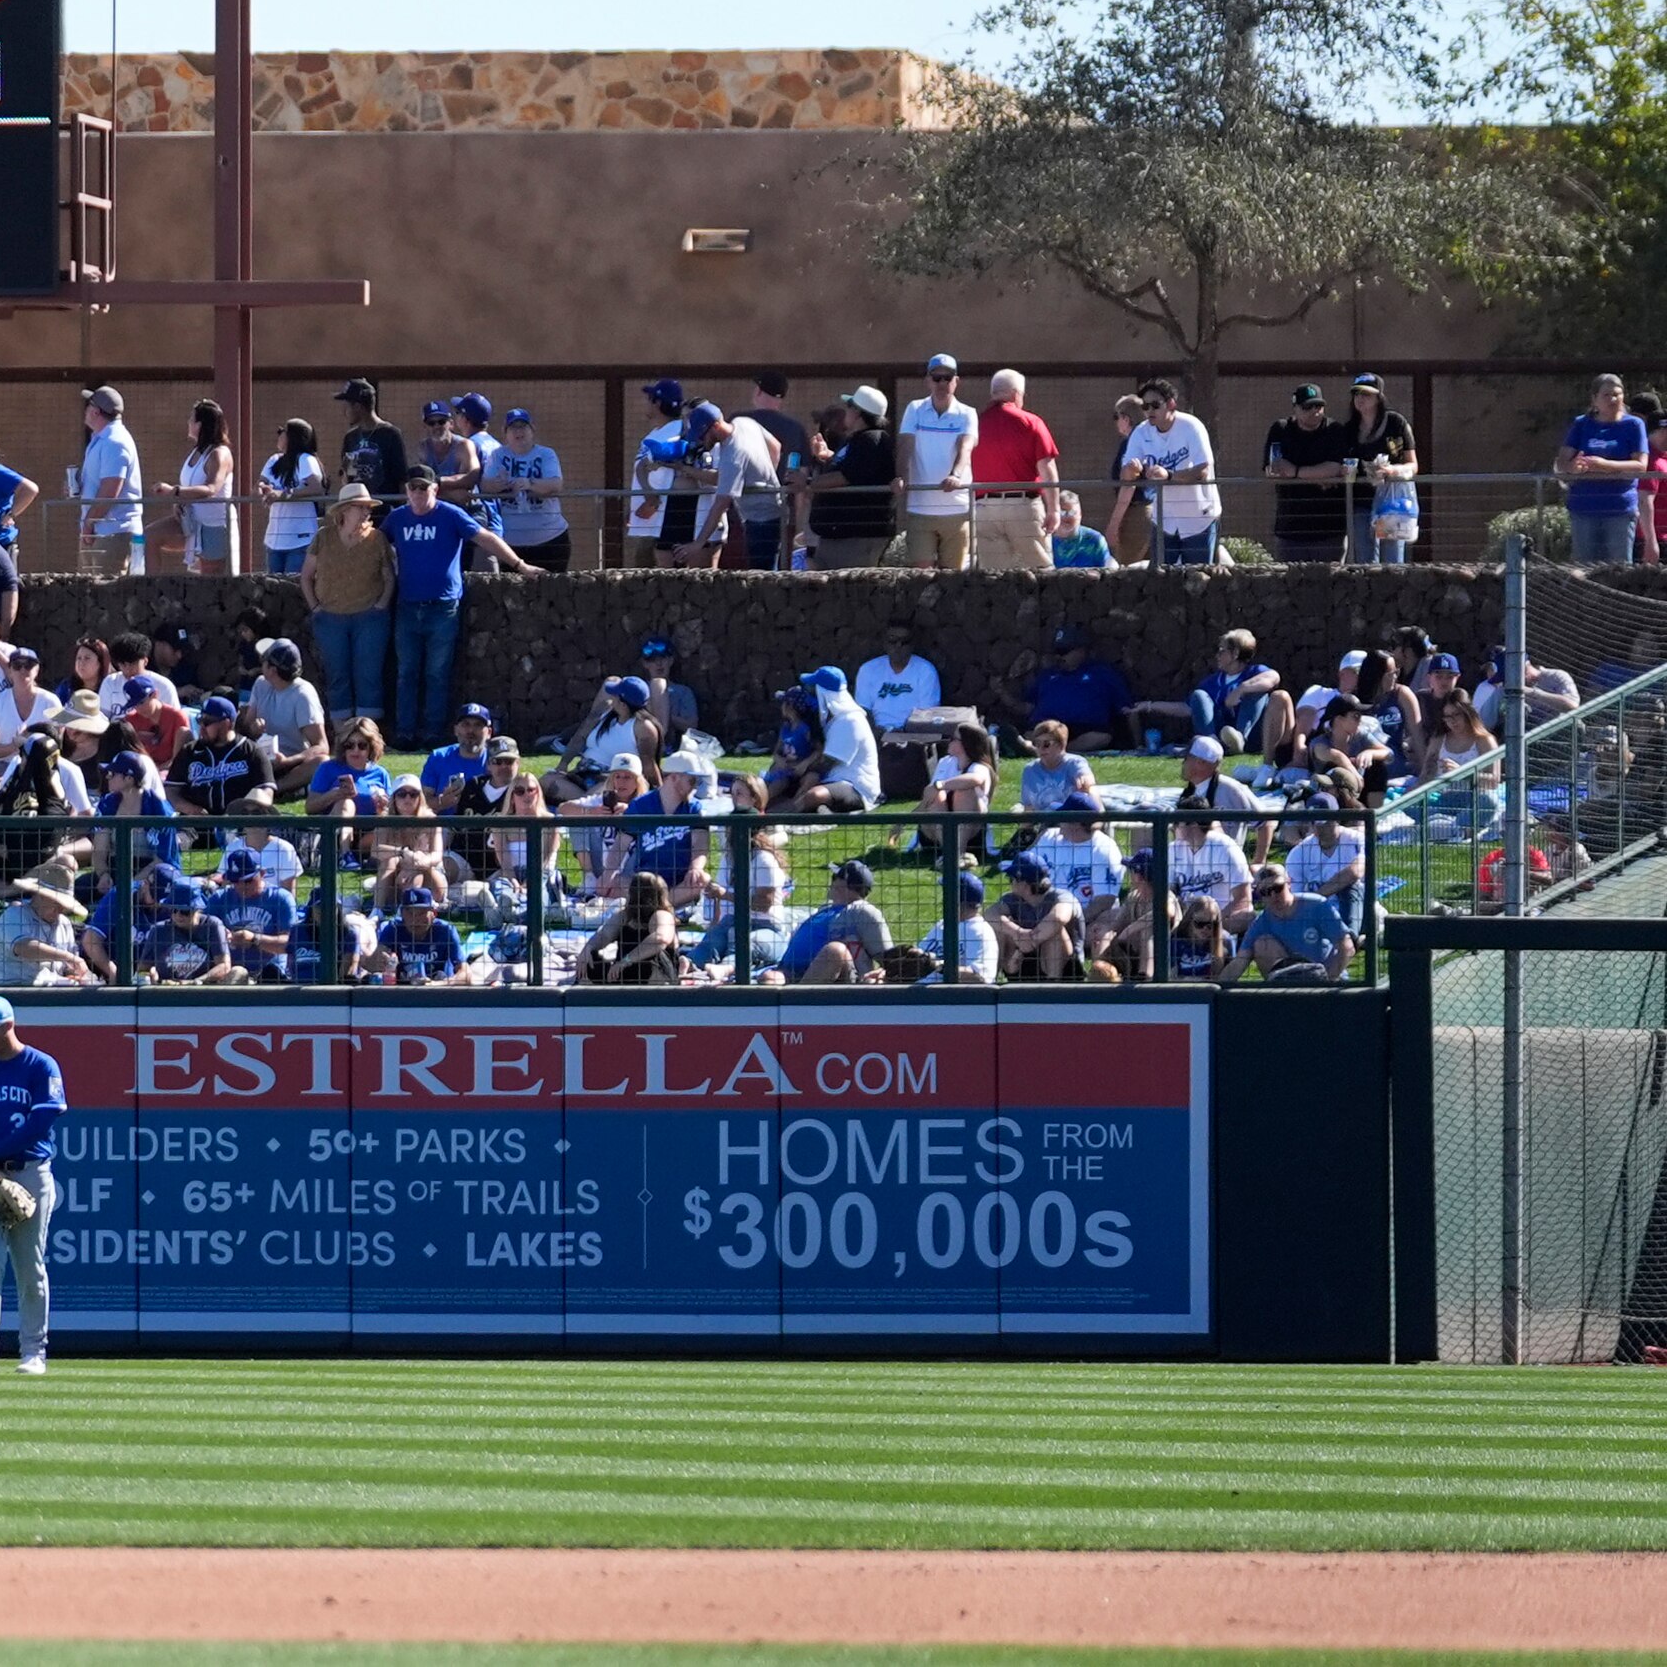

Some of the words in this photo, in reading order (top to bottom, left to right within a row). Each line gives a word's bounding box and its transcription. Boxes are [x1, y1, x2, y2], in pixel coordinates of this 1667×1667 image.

[189, 760, 249, 786] Dodgers
[1176, 869, 1224, 892] Dodgers
[401, 950, 438, 964] WORLD
[124, 1031, 803, 1096] ESTRELLA
[394, 1129, 527, 1164] PARKS
[719, 1116, 1025, 1185] HOMES
[1043, 1123, 1133, 1148] FROM
[1042, 1155, 1104, 1181] THE
[183, 1180, 255, 1214] 65+
[270, 1180, 397, 1215] MILES
[408, 1180, 443, 1203] OF
[453, 1179, 601, 1216] TRAILS
[260, 1229, 397, 1268] CLUBS
[466, 1230, 604, 1269] LAKES
[682, 1185, 1135, 1278] $300,000s
